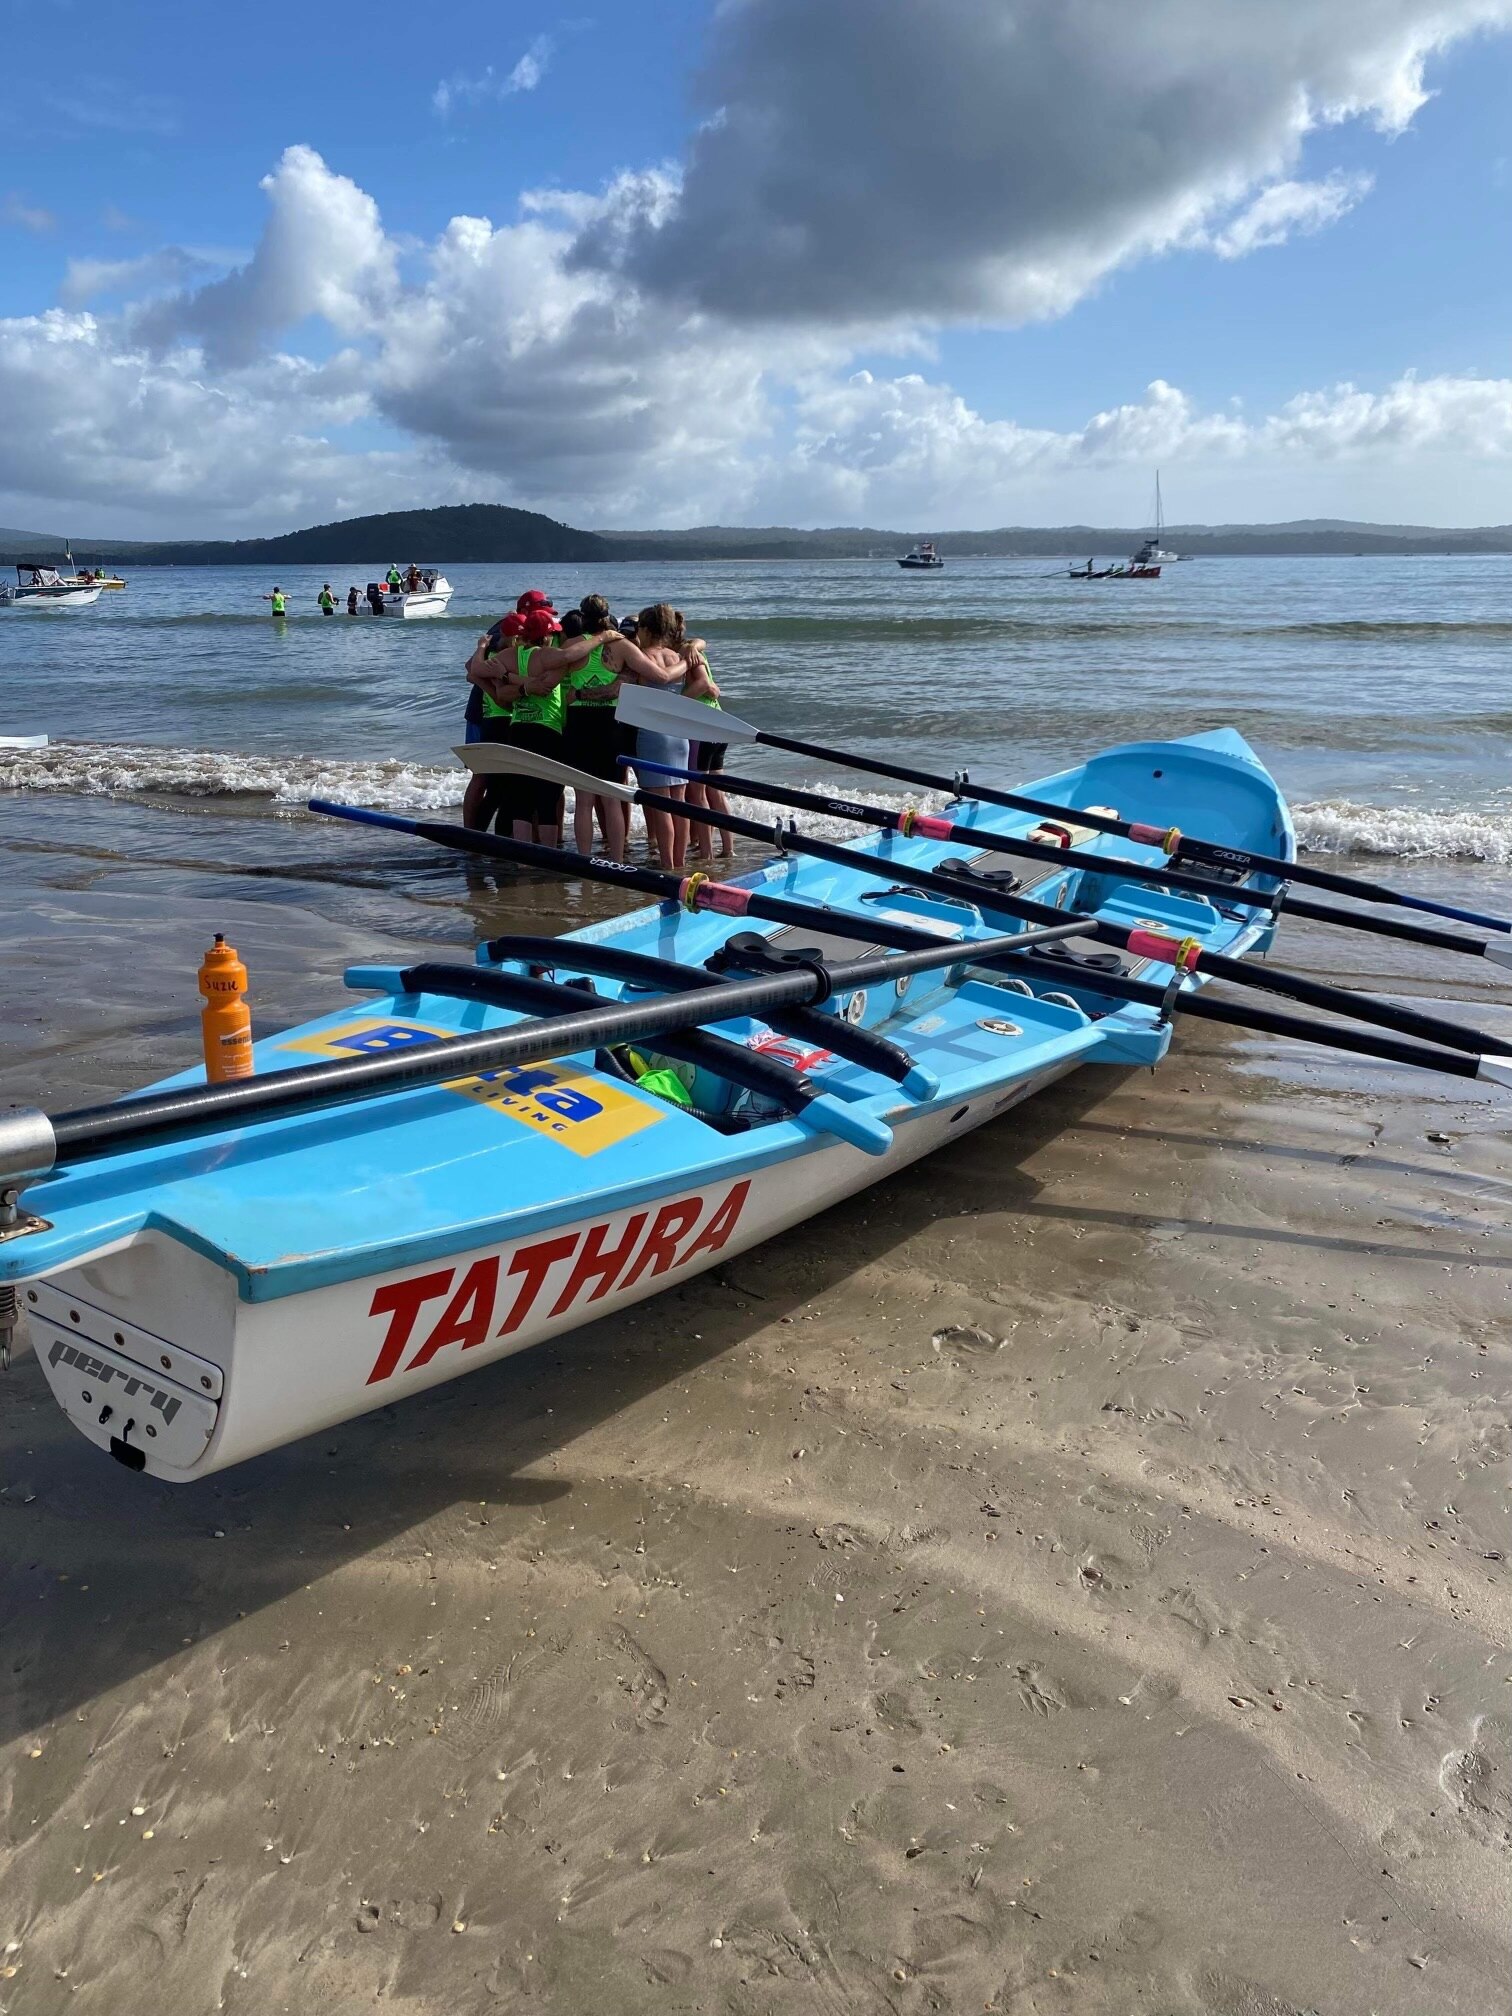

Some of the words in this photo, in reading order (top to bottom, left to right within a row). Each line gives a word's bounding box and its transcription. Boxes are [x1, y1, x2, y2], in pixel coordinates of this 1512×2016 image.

[828, 802, 864, 816] CROKER
[590, 857, 638, 873] CROKER
[1213, 850, 1251, 864] CROKER
[472, 1085, 568, 1132] LIVING
[366, 1179, 752, 1386] TATHRA
[48, 1340, 183, 1426] perry
